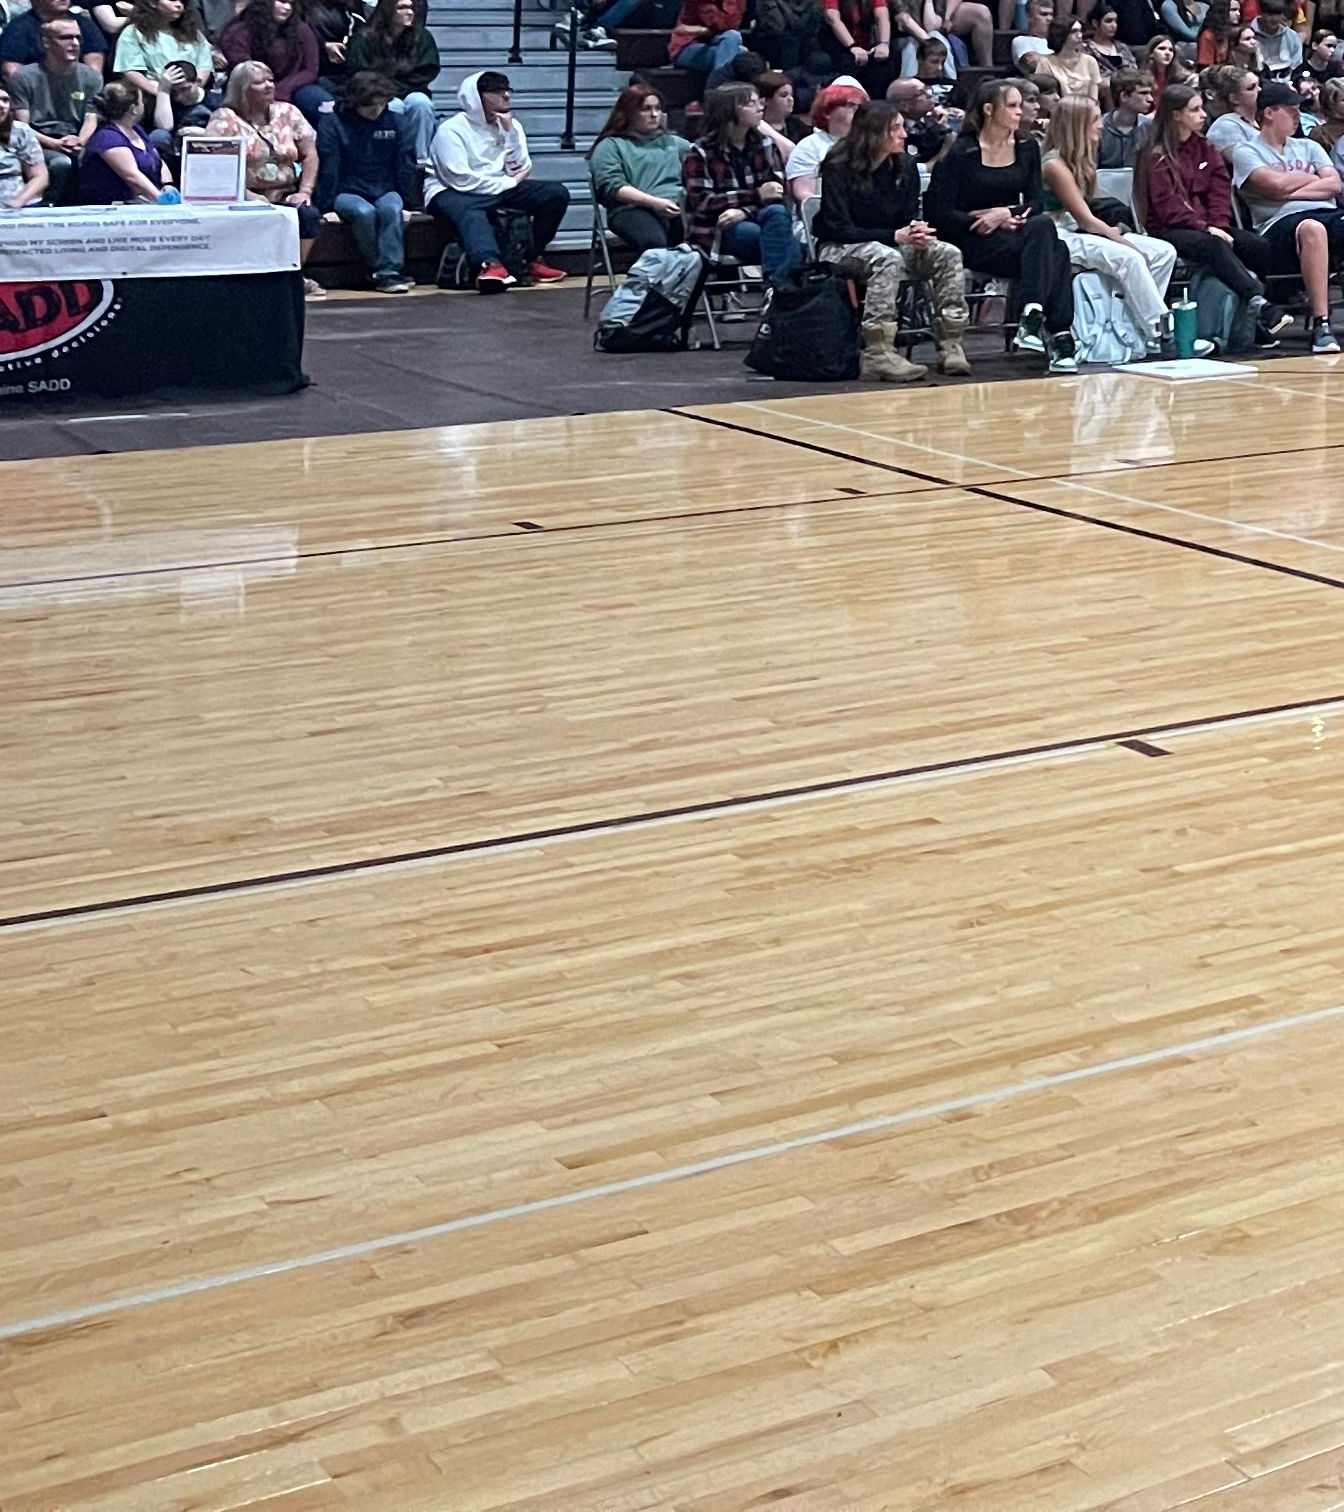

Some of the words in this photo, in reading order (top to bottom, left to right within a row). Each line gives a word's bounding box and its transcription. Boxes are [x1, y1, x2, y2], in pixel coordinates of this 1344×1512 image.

[46, 238, 83, 246] SCREEN
[159, 235, 189, 243] EVERY
[54, 246, 86, 254] LIVING
[27, 378, 71, 393] SADD
